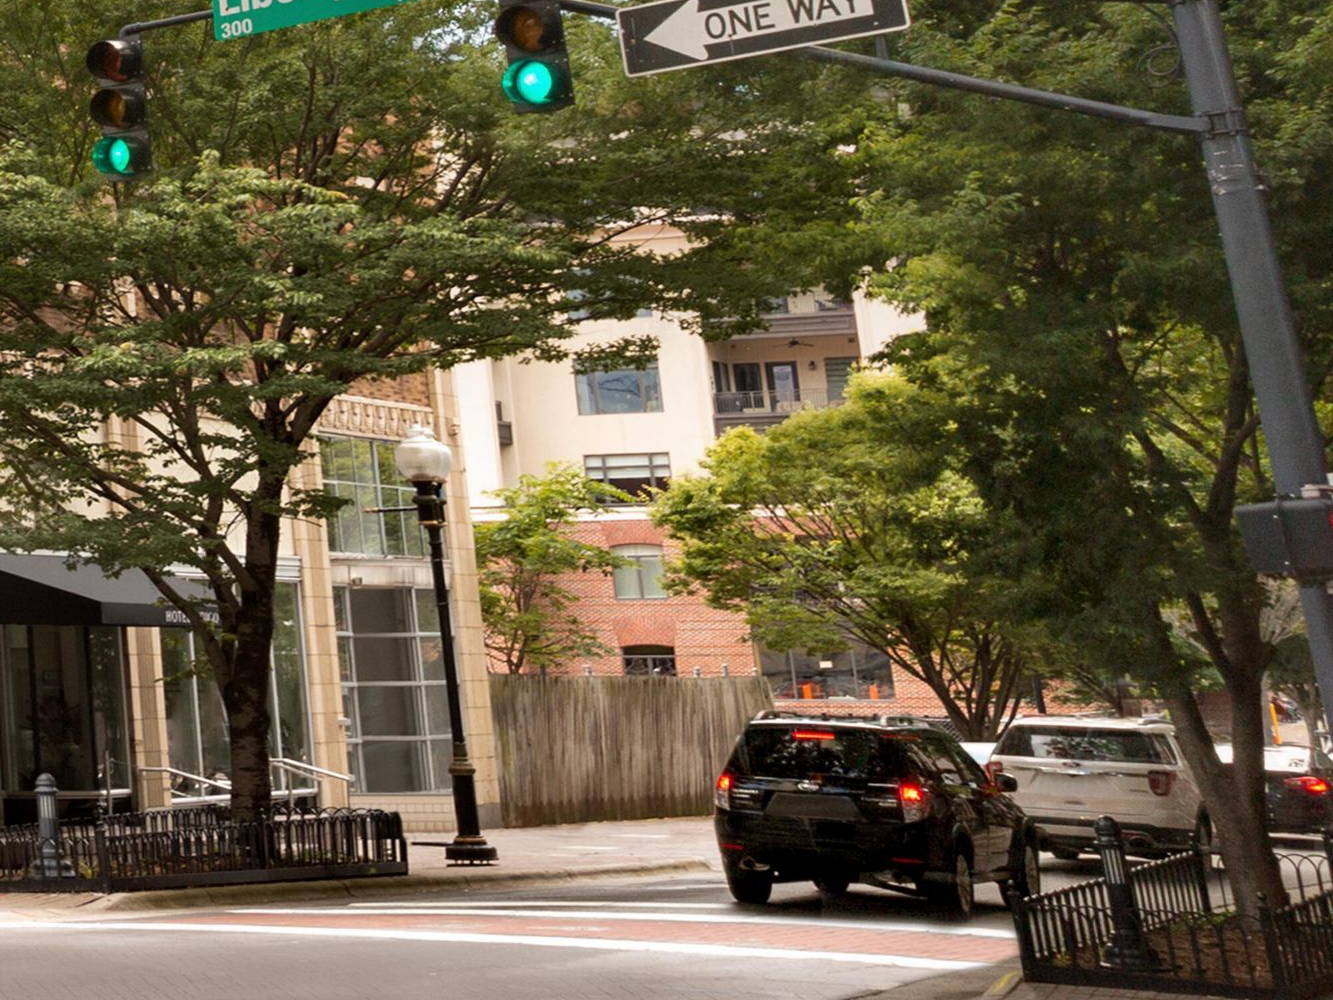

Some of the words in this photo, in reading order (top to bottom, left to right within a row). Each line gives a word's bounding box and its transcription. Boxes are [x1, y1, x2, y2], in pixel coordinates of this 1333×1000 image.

[220, 18, 253, 39] 300
[704, 2, 775, 39] ONE
[165, 610, 191, 623] HOTEL
